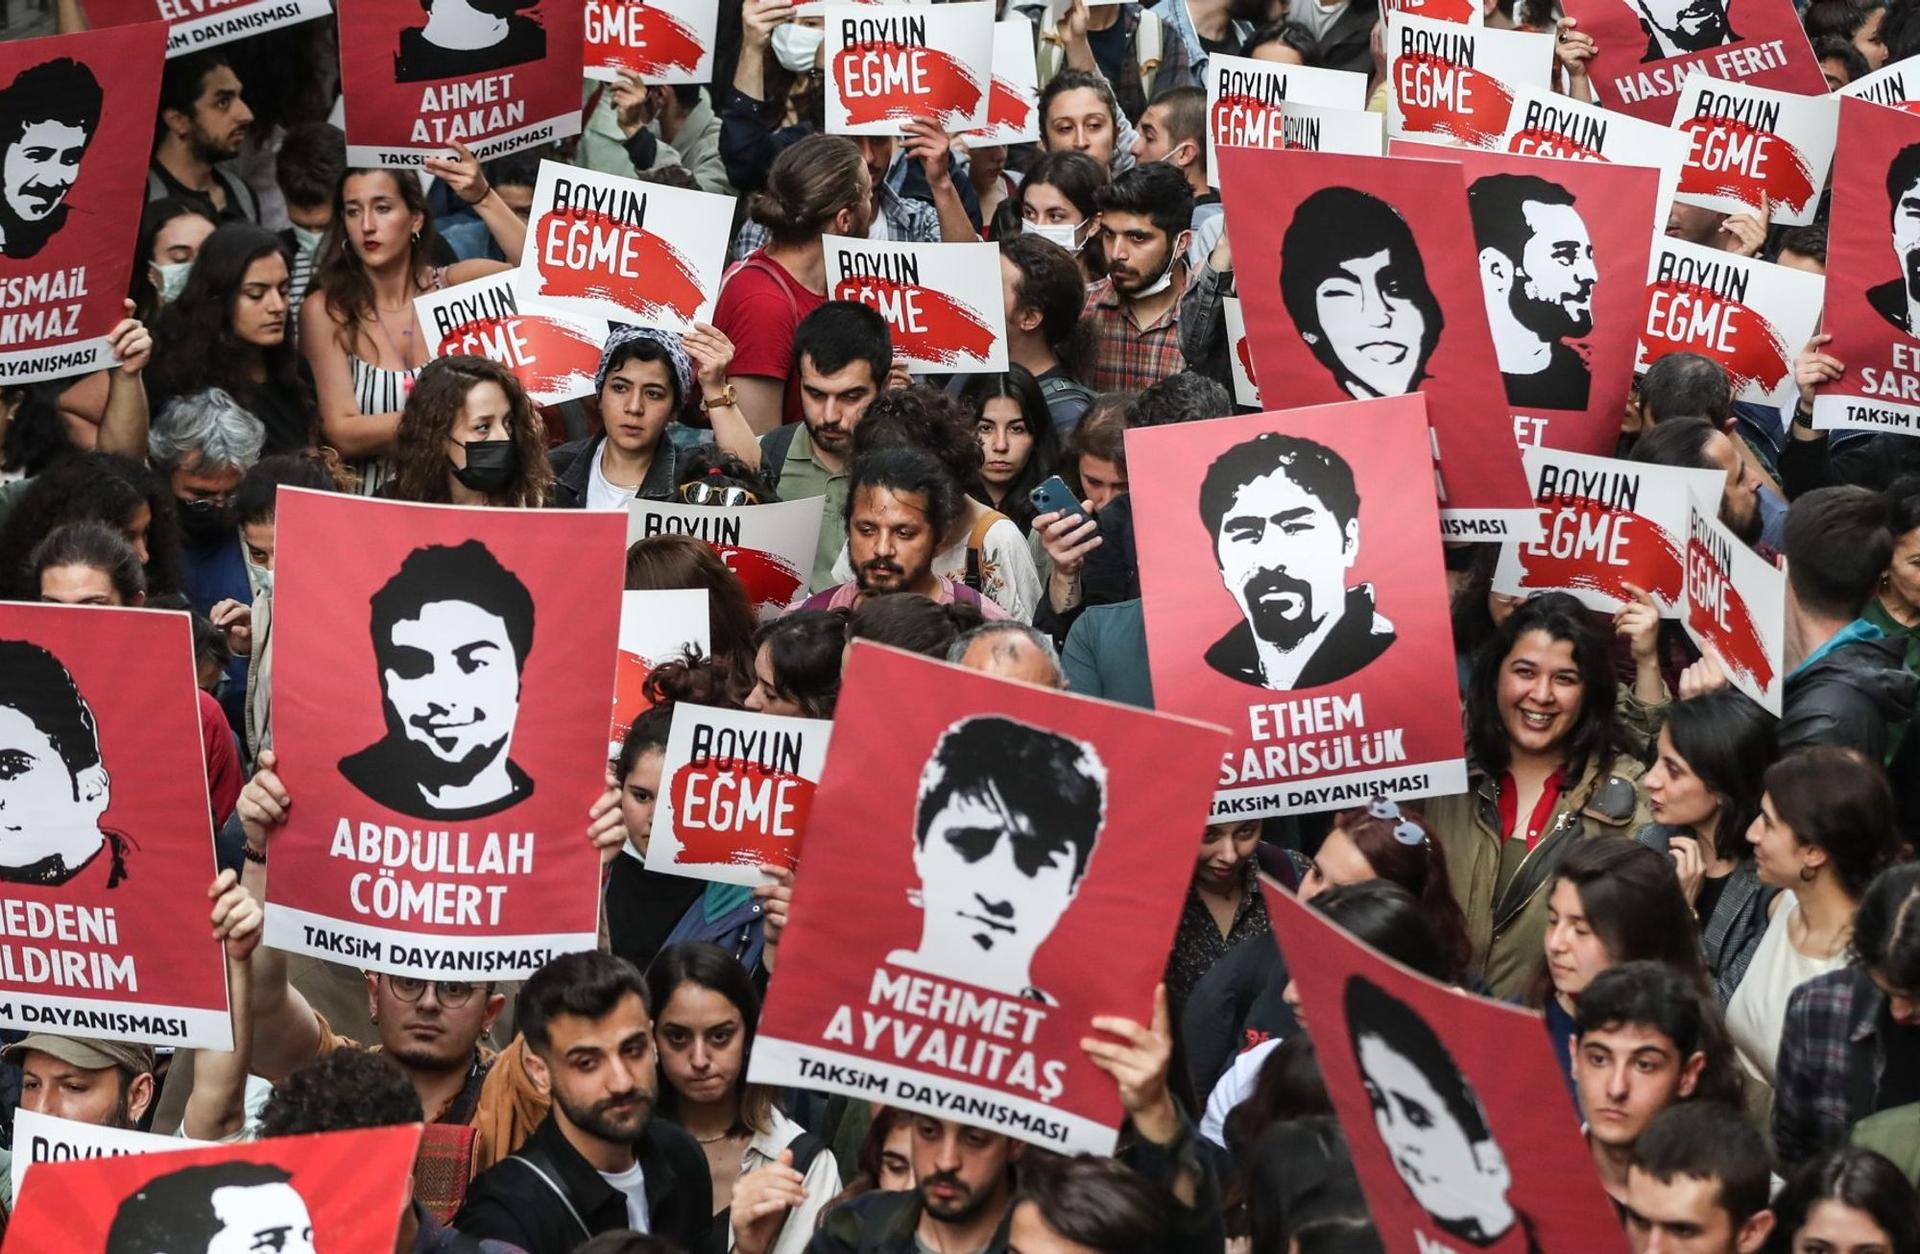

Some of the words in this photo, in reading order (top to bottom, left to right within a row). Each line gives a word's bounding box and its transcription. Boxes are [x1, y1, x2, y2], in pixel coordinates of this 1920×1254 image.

[192, 2, 302, 43] DAYANIŞMASI
[842, 15, 926, 52] BOYUN
[1401, 26, 1475, 68] BOYUN
[419, 73, 514, 113] AHMET
[843, 51, 931, 98] EĞME
[1218, 68, 1287, 108] BOYUN
[1401, 62, 1474, 114] EĞME
[410, 100, 525, 143] ATAKAN
[1284, 115, 1320, 151] BOYUN
[1524, 100, 1607, 154] BOYUN
[1694, 89, 1780, 134] BOYUN
[1683, 125, 1772, 179] EĞME
[552, 178, 646, 228] BOYUN
[545, 219, 641, 278] EĞME
[838, 250, 920, 286] BOYUN
[1657, 251, 1749, 304] BOYUN
[0, 304, 82, 345] KMAZ
[433, 282, 518, 342] BOYUN
[1646, 290, 1743, 353] EĞME
[1537, 464, 1640, 513] BOYUN
[1527, 507, 1633, 566] EĞME
[1691, 505, 1732, 581] BOYUN
[1689, 547, 1732, 633] EĞME
[1248, 692, 1365, 741] ETHEM
[690, 723, 802, 776] BOYUN
[1218, 727, 1407, 786] SARISÜLÜK
[682, 771, 798, 837] EĞME
[329, 818, 535, 875] ABDULLAH
[350, 868, 508, 926] CÖMERT
[389, 945, 552, 972] DAYANIŞMASI
[21, 1004, 188, 1038] DAYANIŞMASI
[868, 967, 1047, 1044] MEHMET
[822, 1004, 1067, 1104] AYVALITAŞ
[896, 1080, 1070, 1143] DAYANIŞMASI
